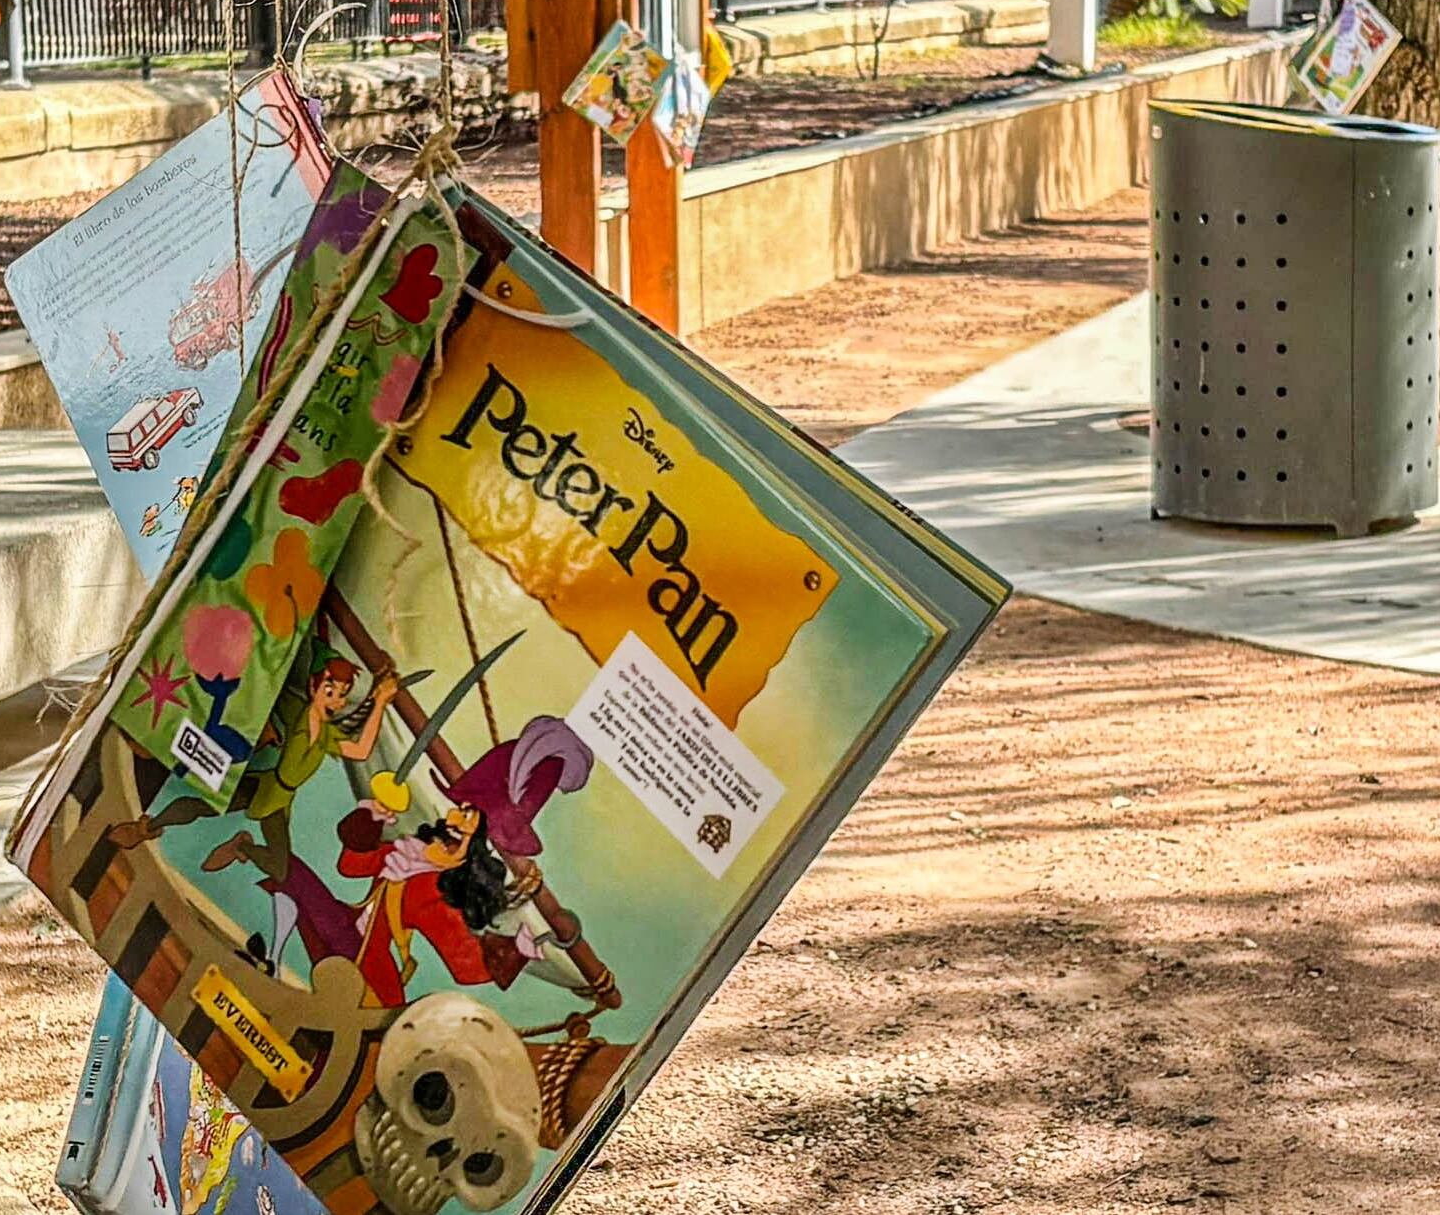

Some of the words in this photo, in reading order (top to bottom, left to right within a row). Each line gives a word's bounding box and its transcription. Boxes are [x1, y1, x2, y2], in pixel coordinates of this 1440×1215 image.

[440, 363, 632, 538] Peter
[609, 490, 741, 693] Pan
[212, 990, 290, 1075] EVEREST
